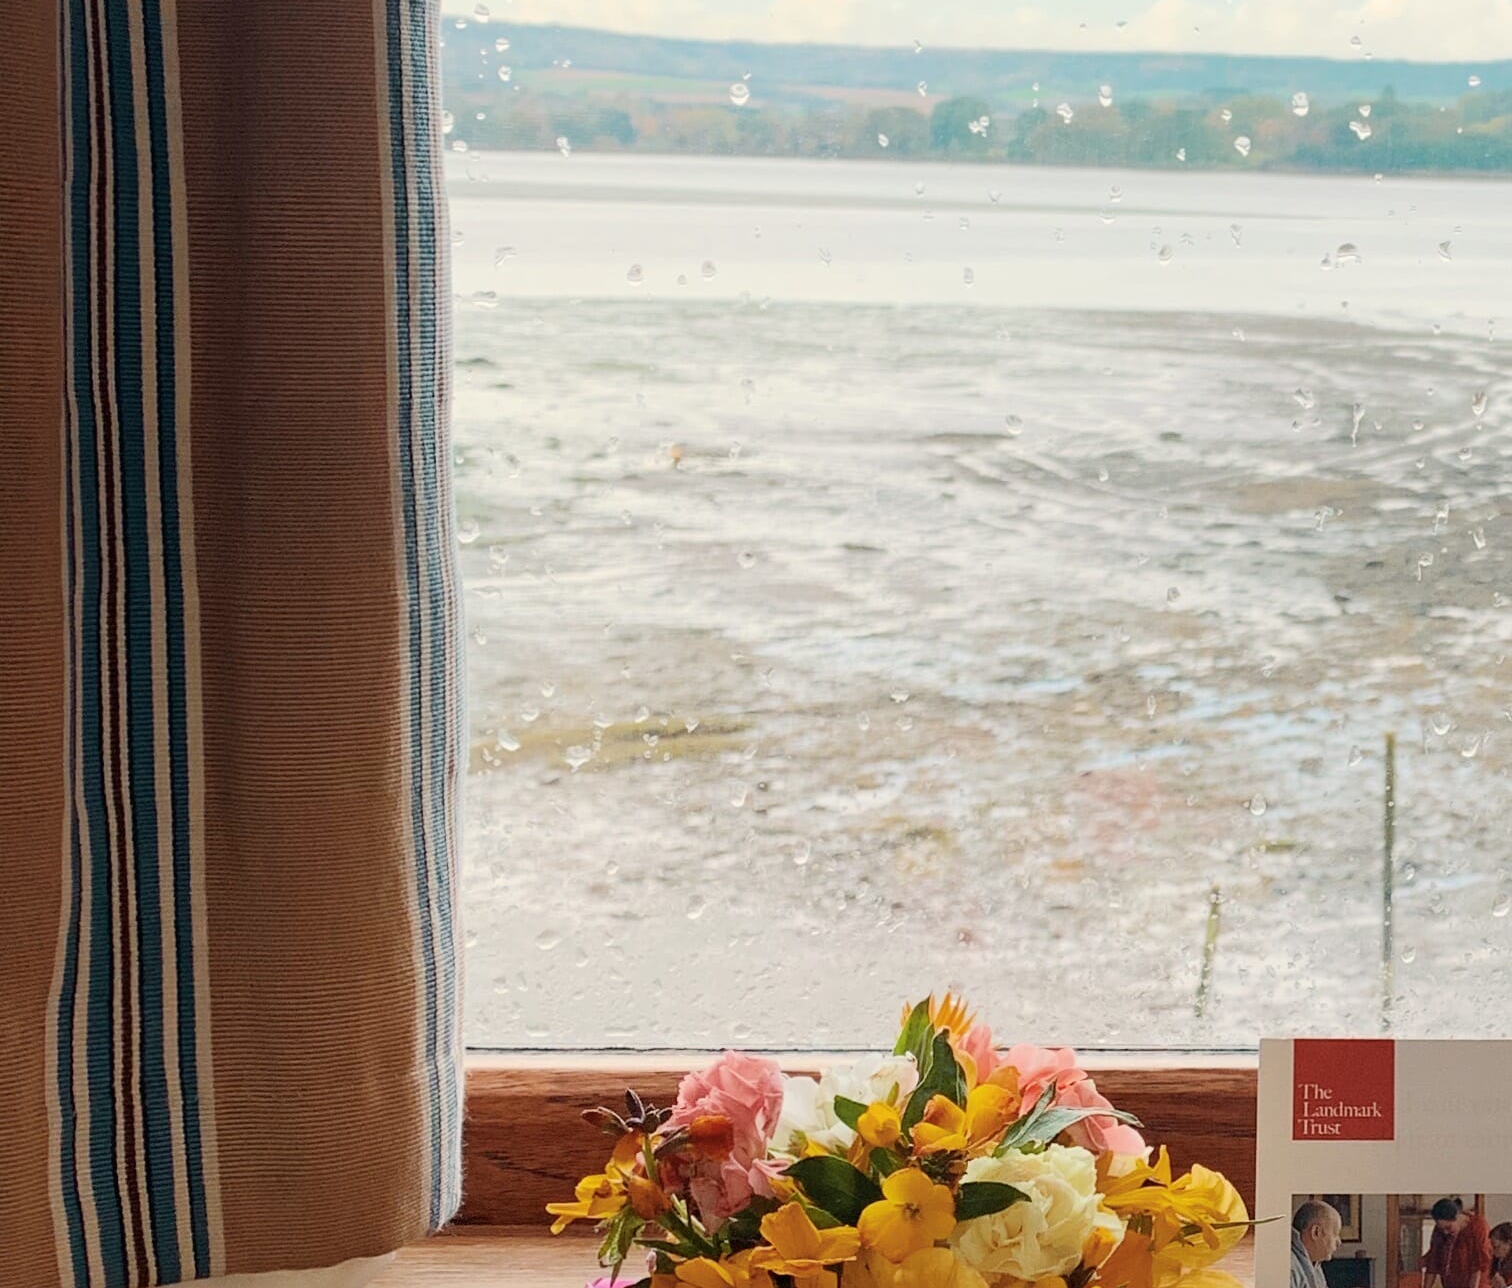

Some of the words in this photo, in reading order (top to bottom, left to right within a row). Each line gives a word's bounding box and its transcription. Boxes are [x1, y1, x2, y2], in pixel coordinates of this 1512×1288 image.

[1298, 1083, 1333, 1100] The
[1303, 1101, 1382, 1118] Landmark
[1298, 1118, 1342, 1135] Trust
